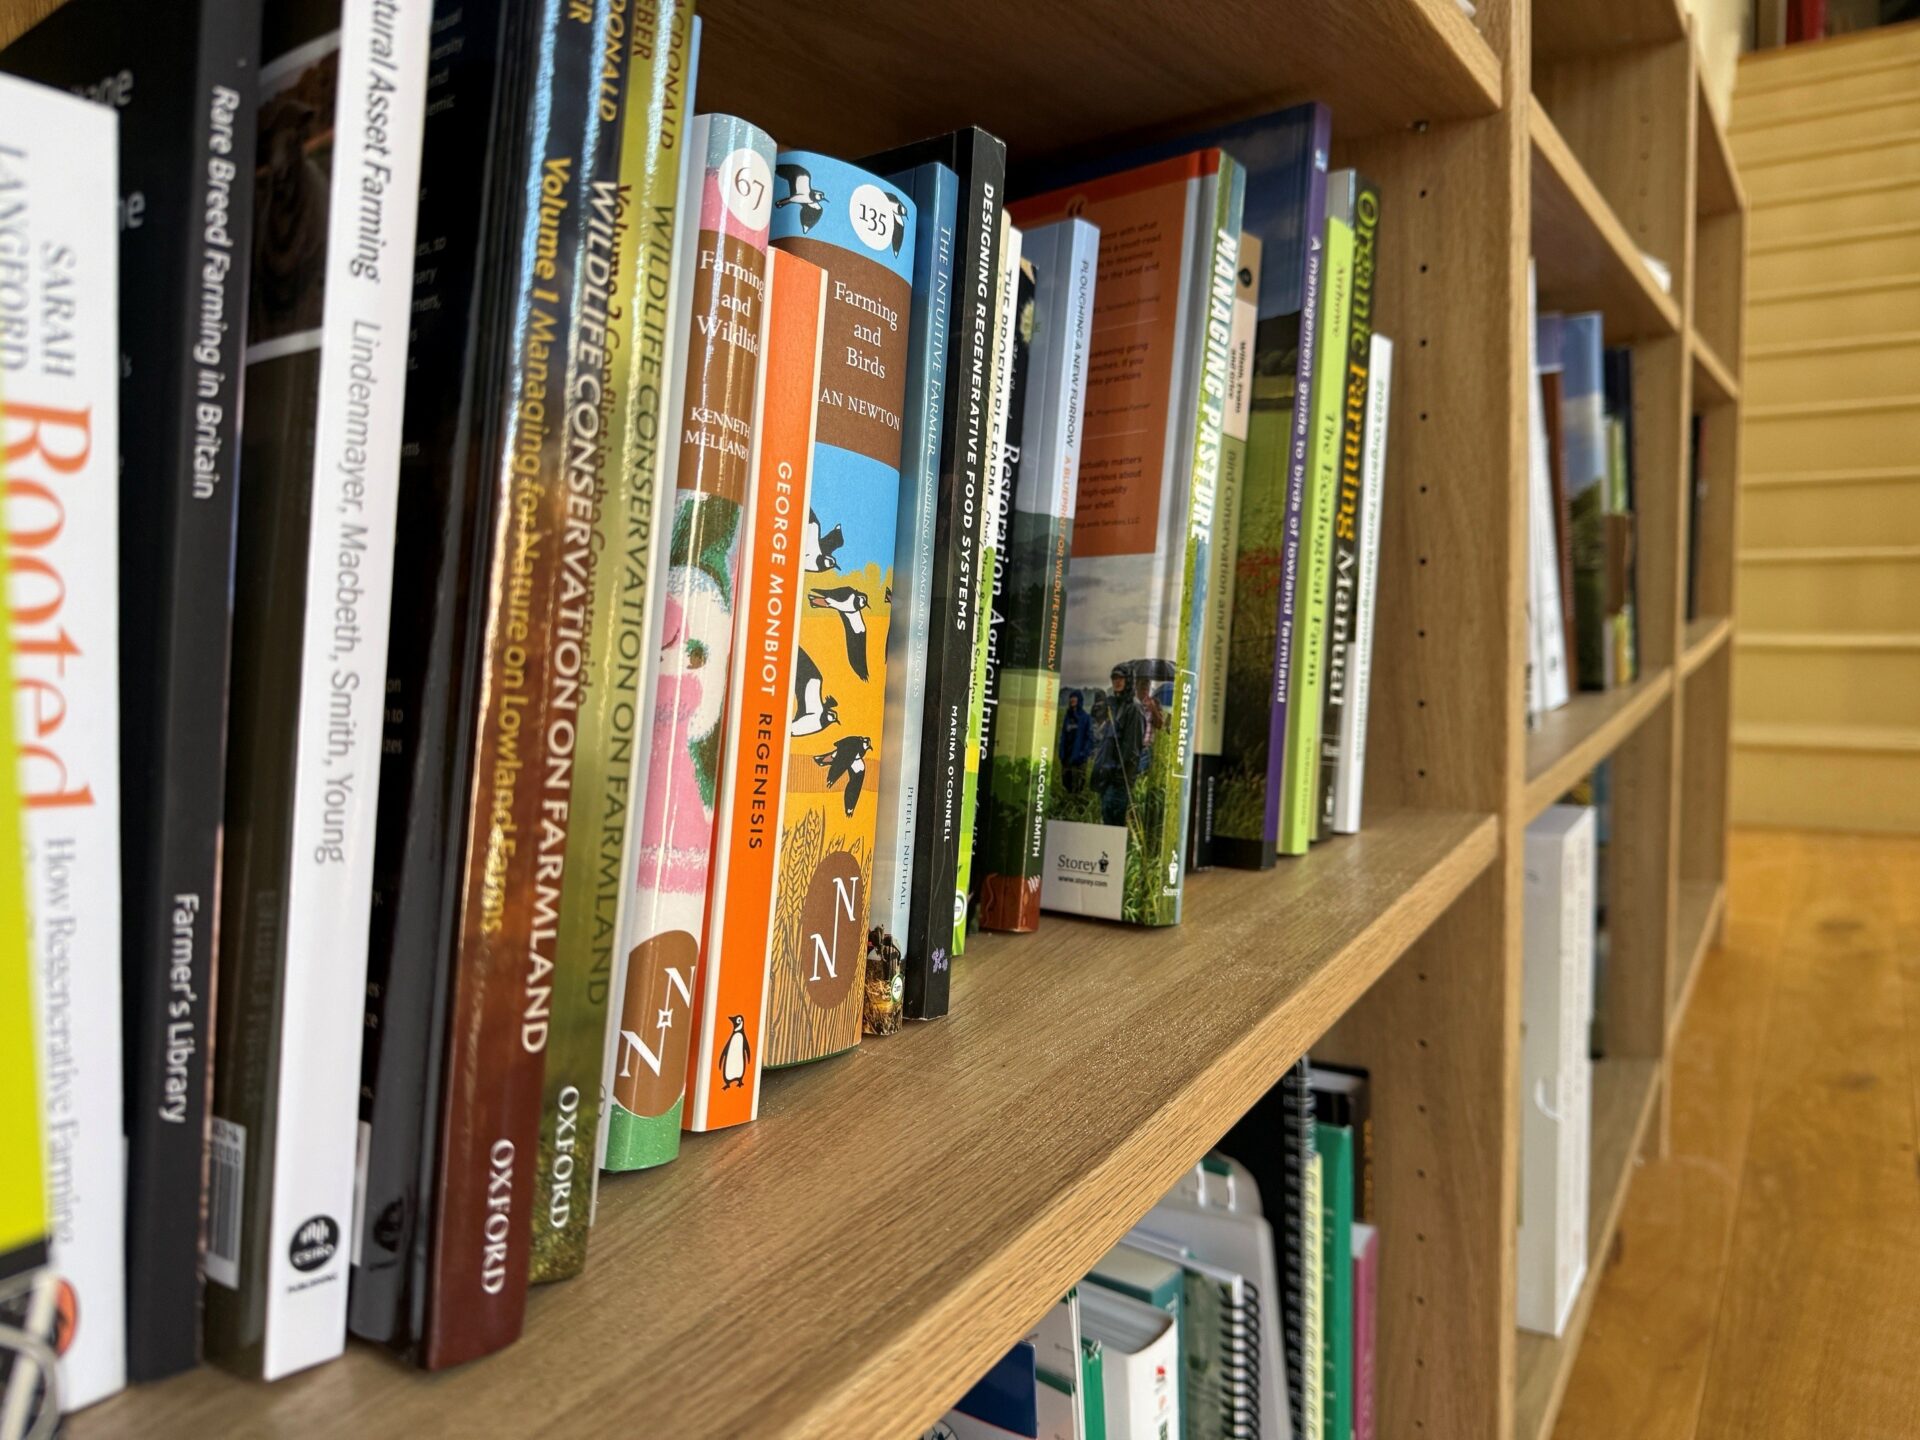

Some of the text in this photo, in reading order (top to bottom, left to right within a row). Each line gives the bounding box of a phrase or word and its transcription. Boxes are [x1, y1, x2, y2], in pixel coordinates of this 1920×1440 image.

[364, 73, 397, 158] Asset
[349, 163, 393, 284] Farming
[534, 157, 572, 281] Volume
[734, 166, 766, 211] 67
[859, 203, 888, 237] 135
[938, 226, 953, 266] THE
[0, 144, 30, 372] LANGFORD
[40, 241, 77, 378] SARAH
[192, 85, 240, 499] Rare Breed Farming in Britain
[578, 180, 618, 370] WILDLIFE
[640, 205, 675, 373] WILDLIFE
[700, 250, 766, 302] Farming
[722, 291, 752, 318] and
[834, 280, 899, 332] Farming
[697, 314, 760, 358] Wildlife
[845, 346, 887, 380] Birds
[853, 322, 883, 349] and
[930, 274, 949, 373] INTUITIVE
[336, 320, 381, 513] Lindenmayer,
[516, 309, 557, 476] Managing
[690, 406, 751, 440] KENNETH
[818, 386, 901, 432] AN NEWTON
[926, 381, 943, 456] FARMER
[1066, 388, 1080, 448] FURROW
[1328, 190, 1380, 706] Organic Farming Manual
[514, 478, 546, 525] for
[943, 181, 995, 843] DESIGNING REGENERATIVE FOOD SYSTEMS MARINA O'CONNELL
[991, 442, 1021, 597] Restoration
[1175, 227, 1238, 766] MANAGING PASTURE Strickler
[1276, 235, 1322, 703] A management guide to birds of lowland farmland
[328, 522, 369, 661] Macbeth,
[552, 374, 601, 711] CONSERVATION
[616, 385, 661, 691] CONSERVATION
[1210, 450, 1237, 726] Bird Conservation and Agriculture
[1313, 464, 1333, 605] Ecological
[3, 401, 96, 810] Rooted
[749, 461, 793, 850] GEORGE MONBIOT REGENESIS
[322, 668, 361, 766] Smith,
[503, 650, 527, 689] on
[978, 607, 1005, 761] Agriculture
[490, 695, 525, 832] Lowland
[544, 719, 576, 790] ON
[609, 703, 635, 763] ON
[1036, 746, 1049, 812] MALCOLM
[44, 836, 77, 907] How
[314, 773, 355, 865] Young
[1031, 815, 1043, 858] SMITH
[1057, 854, 1098, 875] Storey
[1058, 874, 1109, 888] www.storey.com
[520, 800, 570, 1054] FARMLAND
[587, 775, 630, 1006] FARMLAND
[45, 916, 80, 1114] Regenerative
[158, 893, 200, 1124] Farmer's Library
[482, 1140, 517, 1296] OXFORD
[547, 1085, 580, 1230] OXFORD
